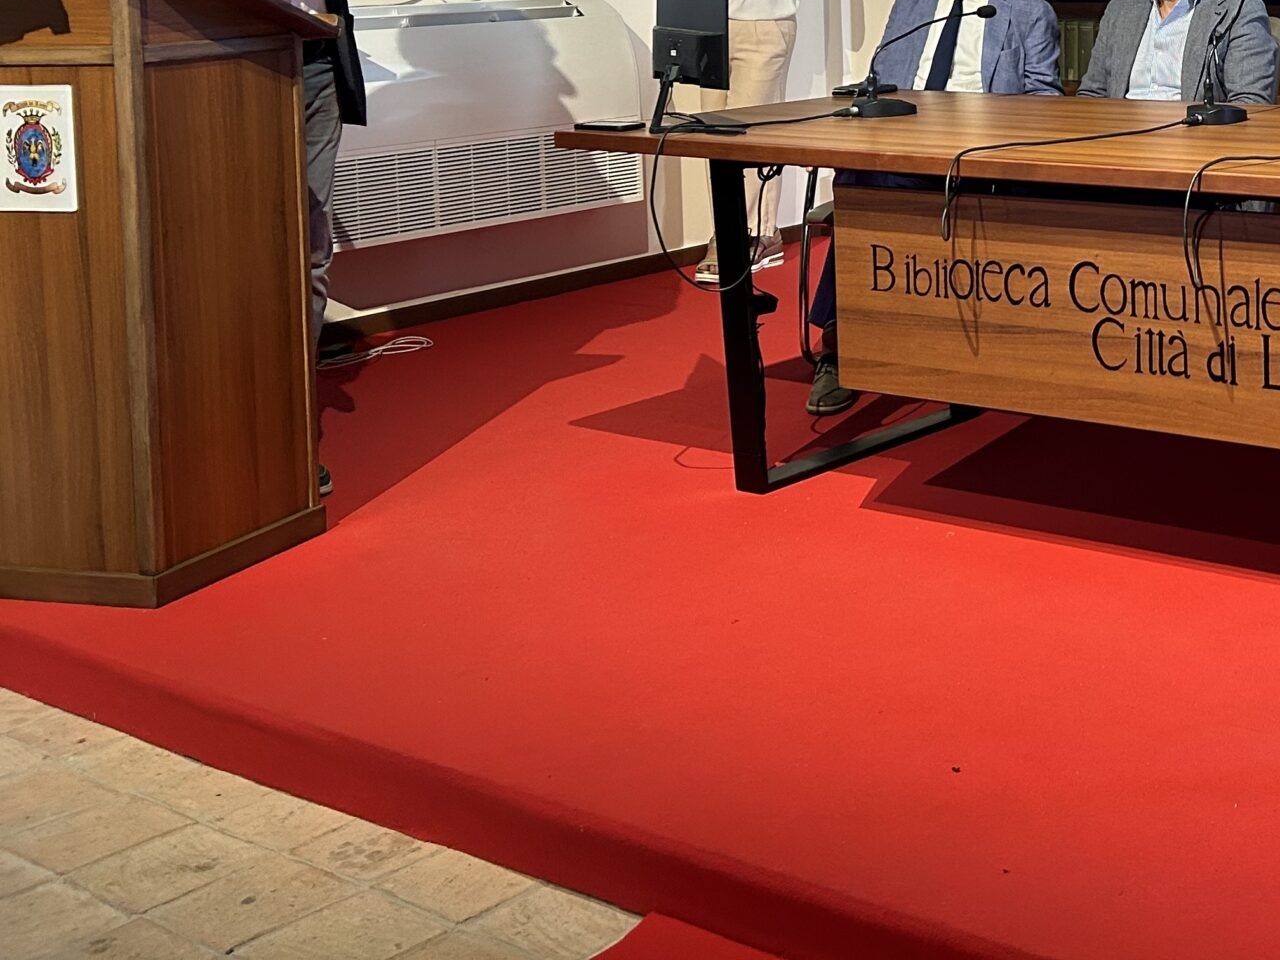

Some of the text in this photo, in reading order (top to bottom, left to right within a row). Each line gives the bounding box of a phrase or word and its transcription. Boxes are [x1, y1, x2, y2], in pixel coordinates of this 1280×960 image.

[870, 243, 1052, 309] Biblioteca
[1091, 316, 1191, 380] Città
[1206, 336, 1239, 387] di
